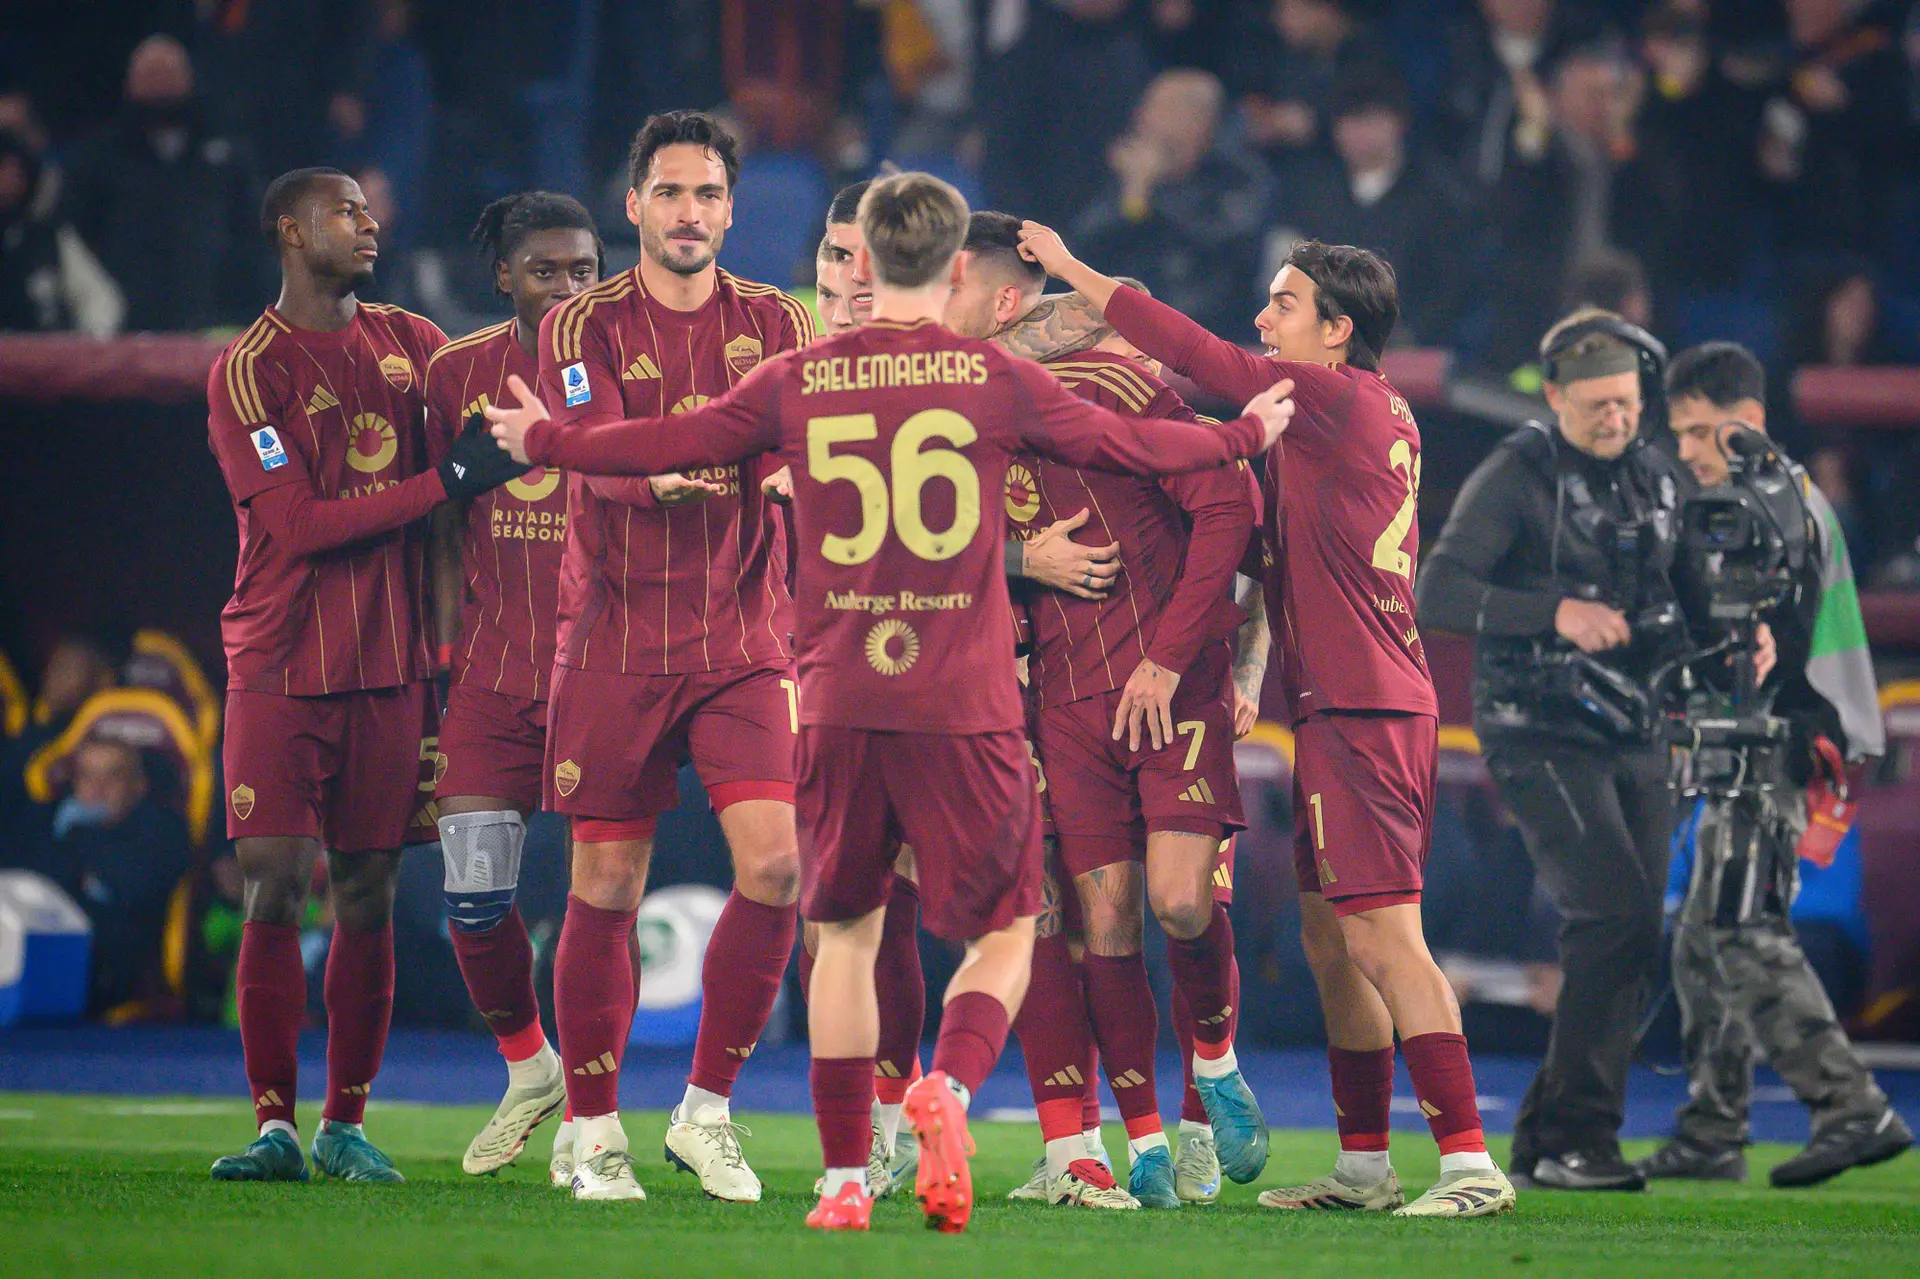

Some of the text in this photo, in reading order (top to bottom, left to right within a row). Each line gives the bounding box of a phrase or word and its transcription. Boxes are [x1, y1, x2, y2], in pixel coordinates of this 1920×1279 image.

[801, 351, 988, 395] SAELEMAEKERS
[688, 465, 739, 481] YADH
[807, 408, 981, 566] 56
[493, 509, 567, 526] RIYADH
[493, 525, 565, 542] SEASON
[1372, 439, 1421, 590] 2
[780, 678, 801, 735] 1
[1176, 720, 1206, 771] 7
